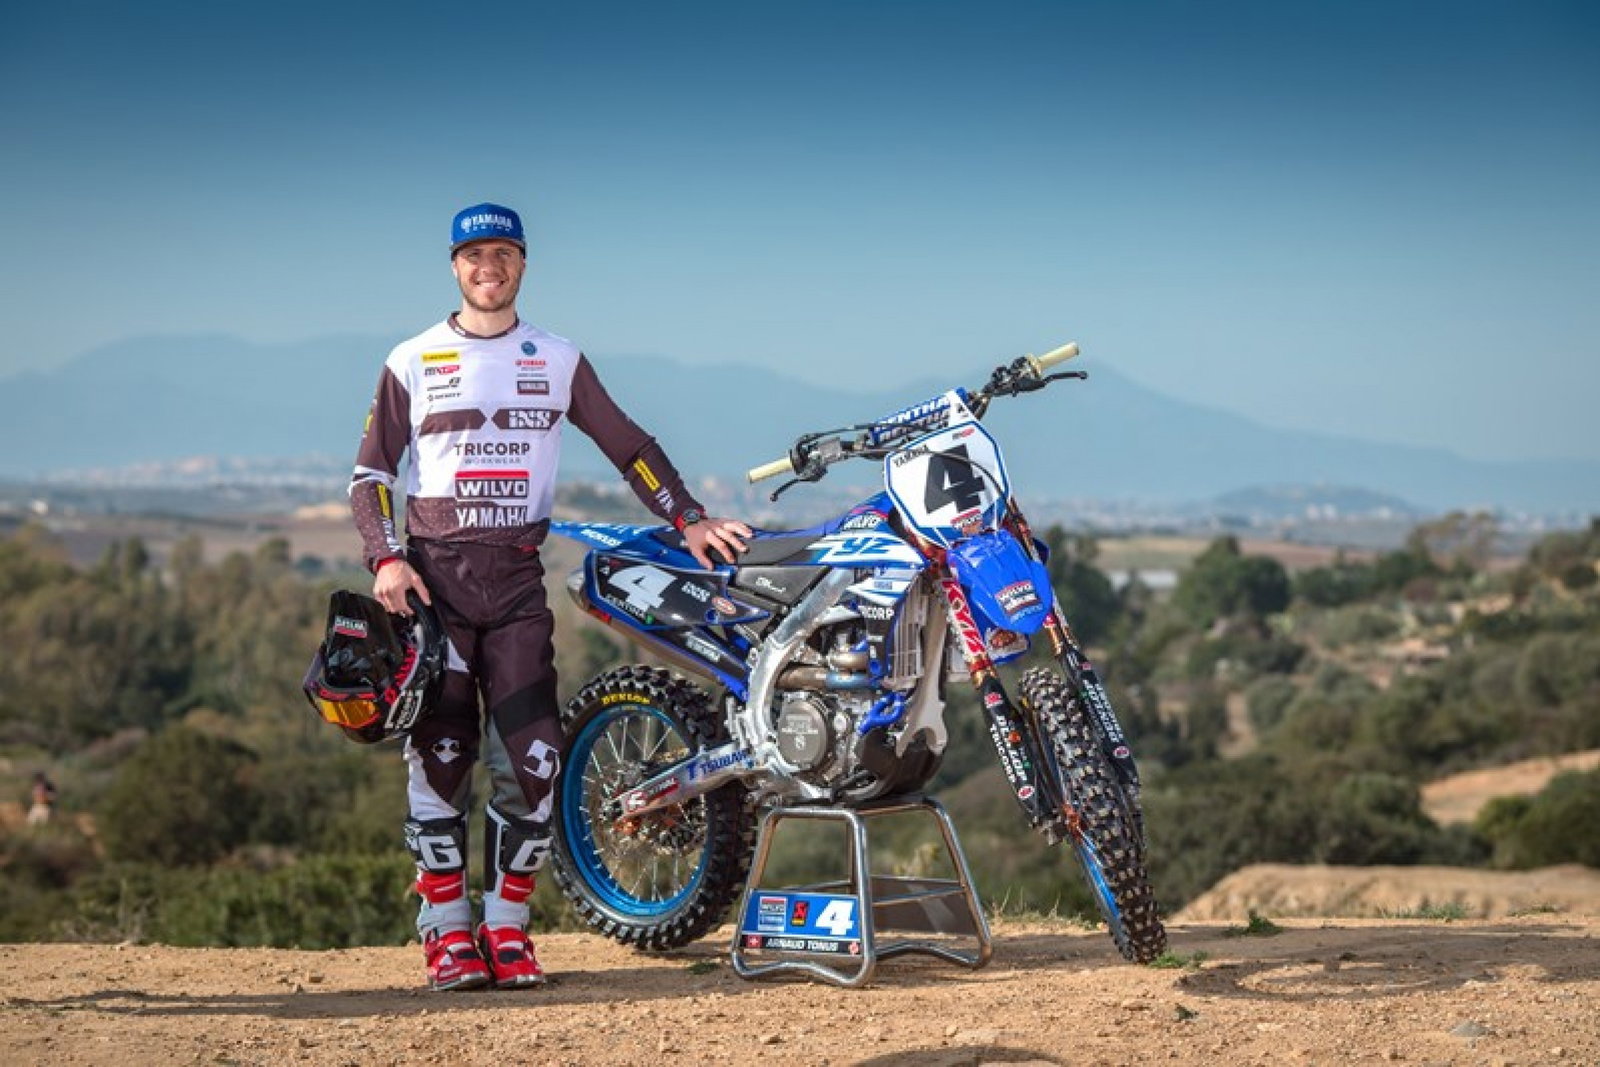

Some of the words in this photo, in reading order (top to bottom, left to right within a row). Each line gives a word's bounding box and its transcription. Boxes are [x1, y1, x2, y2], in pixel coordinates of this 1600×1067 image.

[454, 442, 530, 456] TRICORP
[458, 480, 527, 497] WILVO
[924, 443, 985, 515] 4
[607, 564, 679, 611] 4
[815, 899, 855, 936] 4
[807, 940, 839, 952] TONUS
